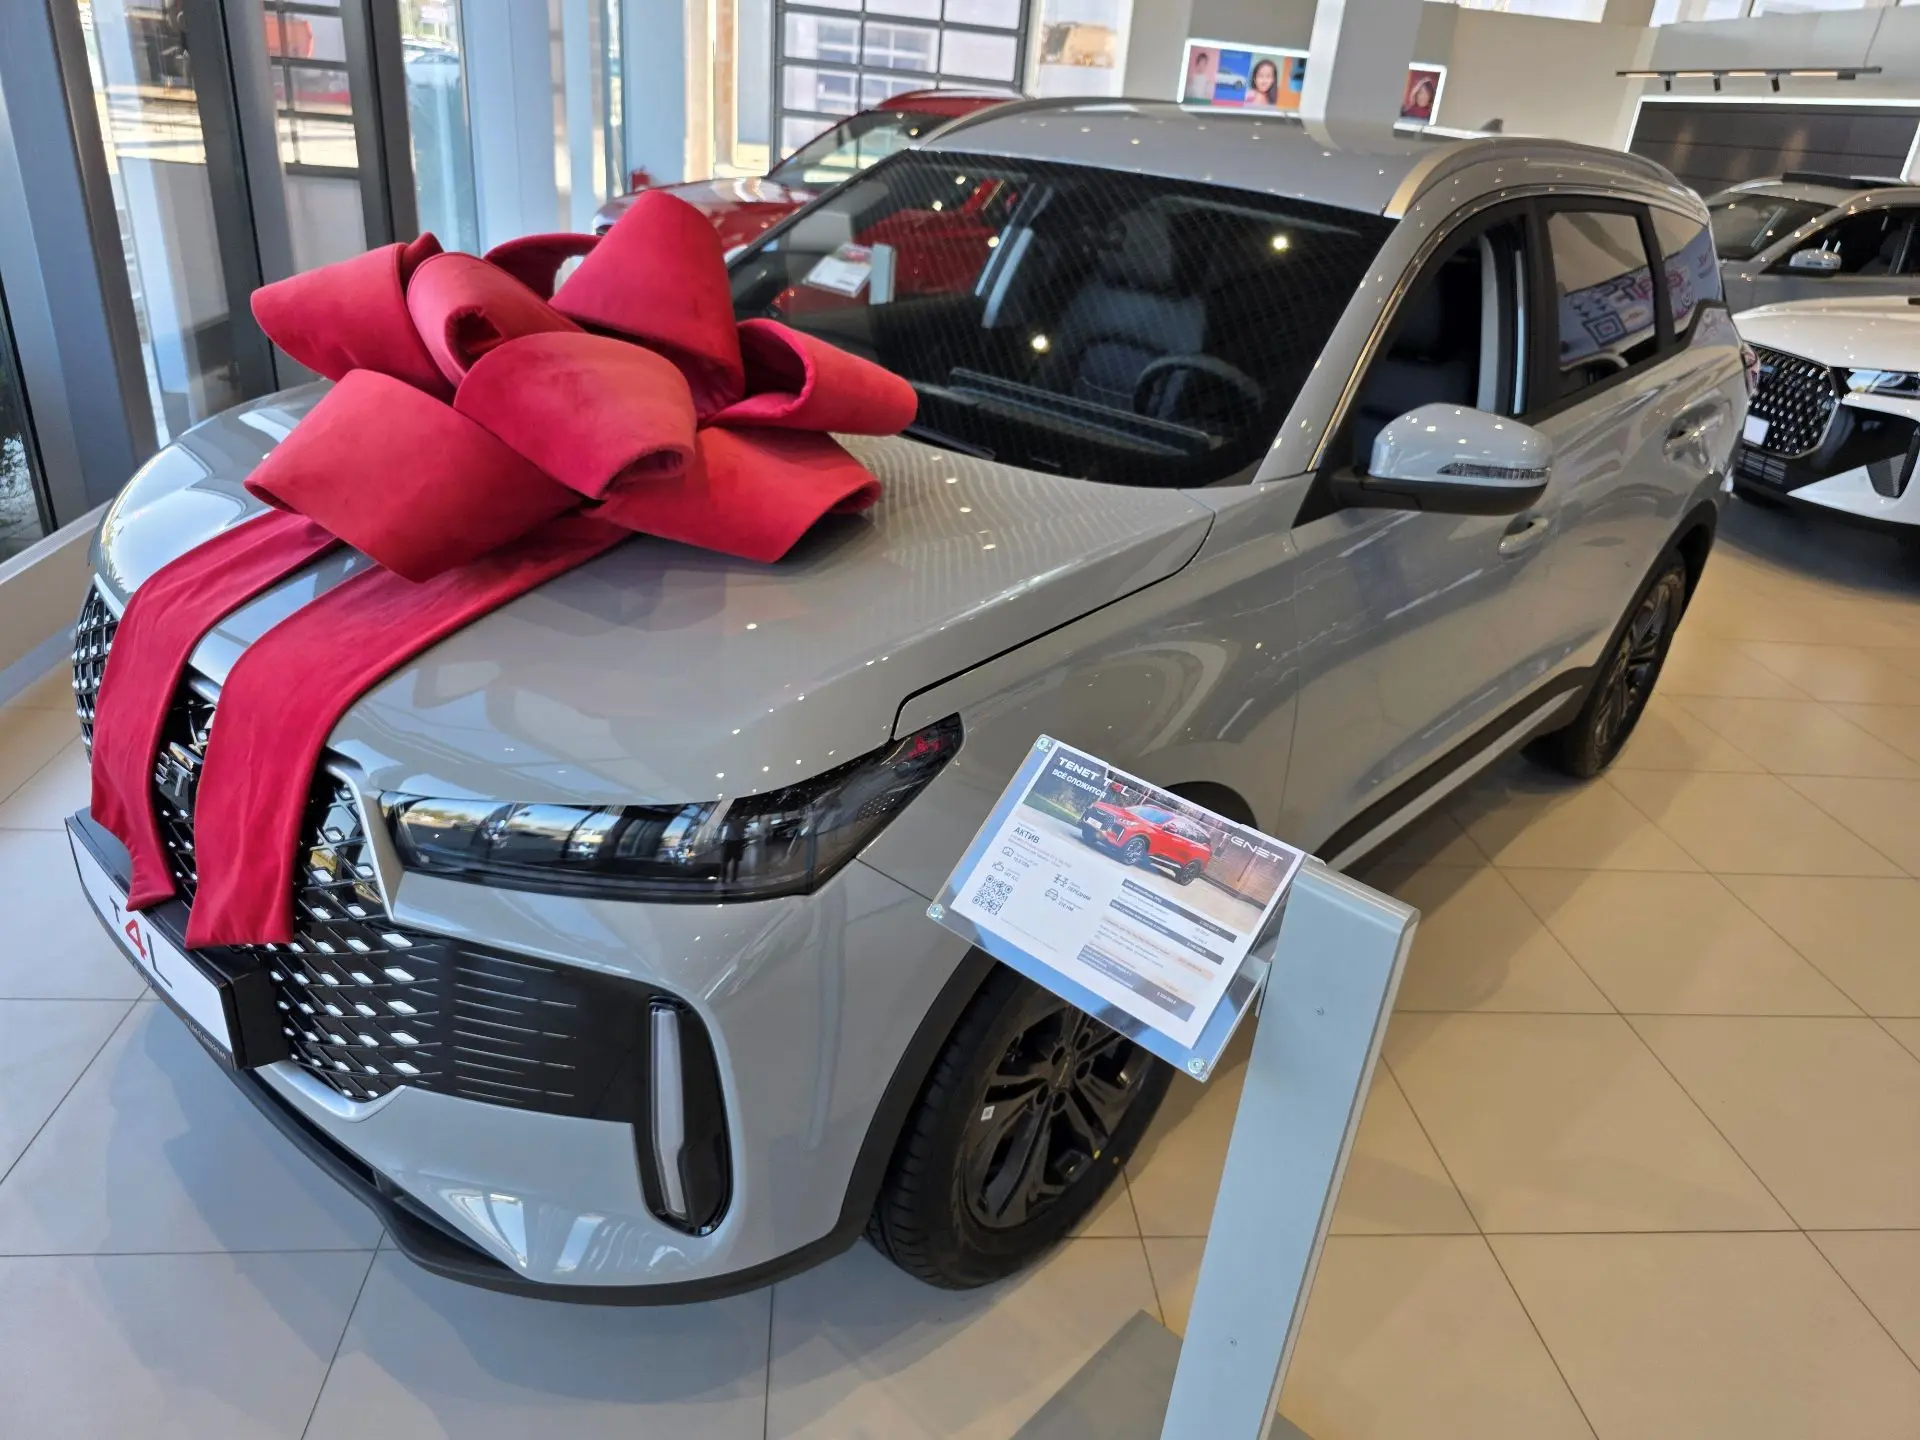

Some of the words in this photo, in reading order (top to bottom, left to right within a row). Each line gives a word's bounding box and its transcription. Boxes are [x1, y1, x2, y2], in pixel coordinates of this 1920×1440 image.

[1059, 757, 1100, 780] TENET
[1051, 768, 1069, 780] ВСЁ
[1066, 774, 1107, 798] СЛОЖИТСЯ
[1014, 827, 1040, 844] АКТИВ
[1222, 832, 1284, 863] TENET
